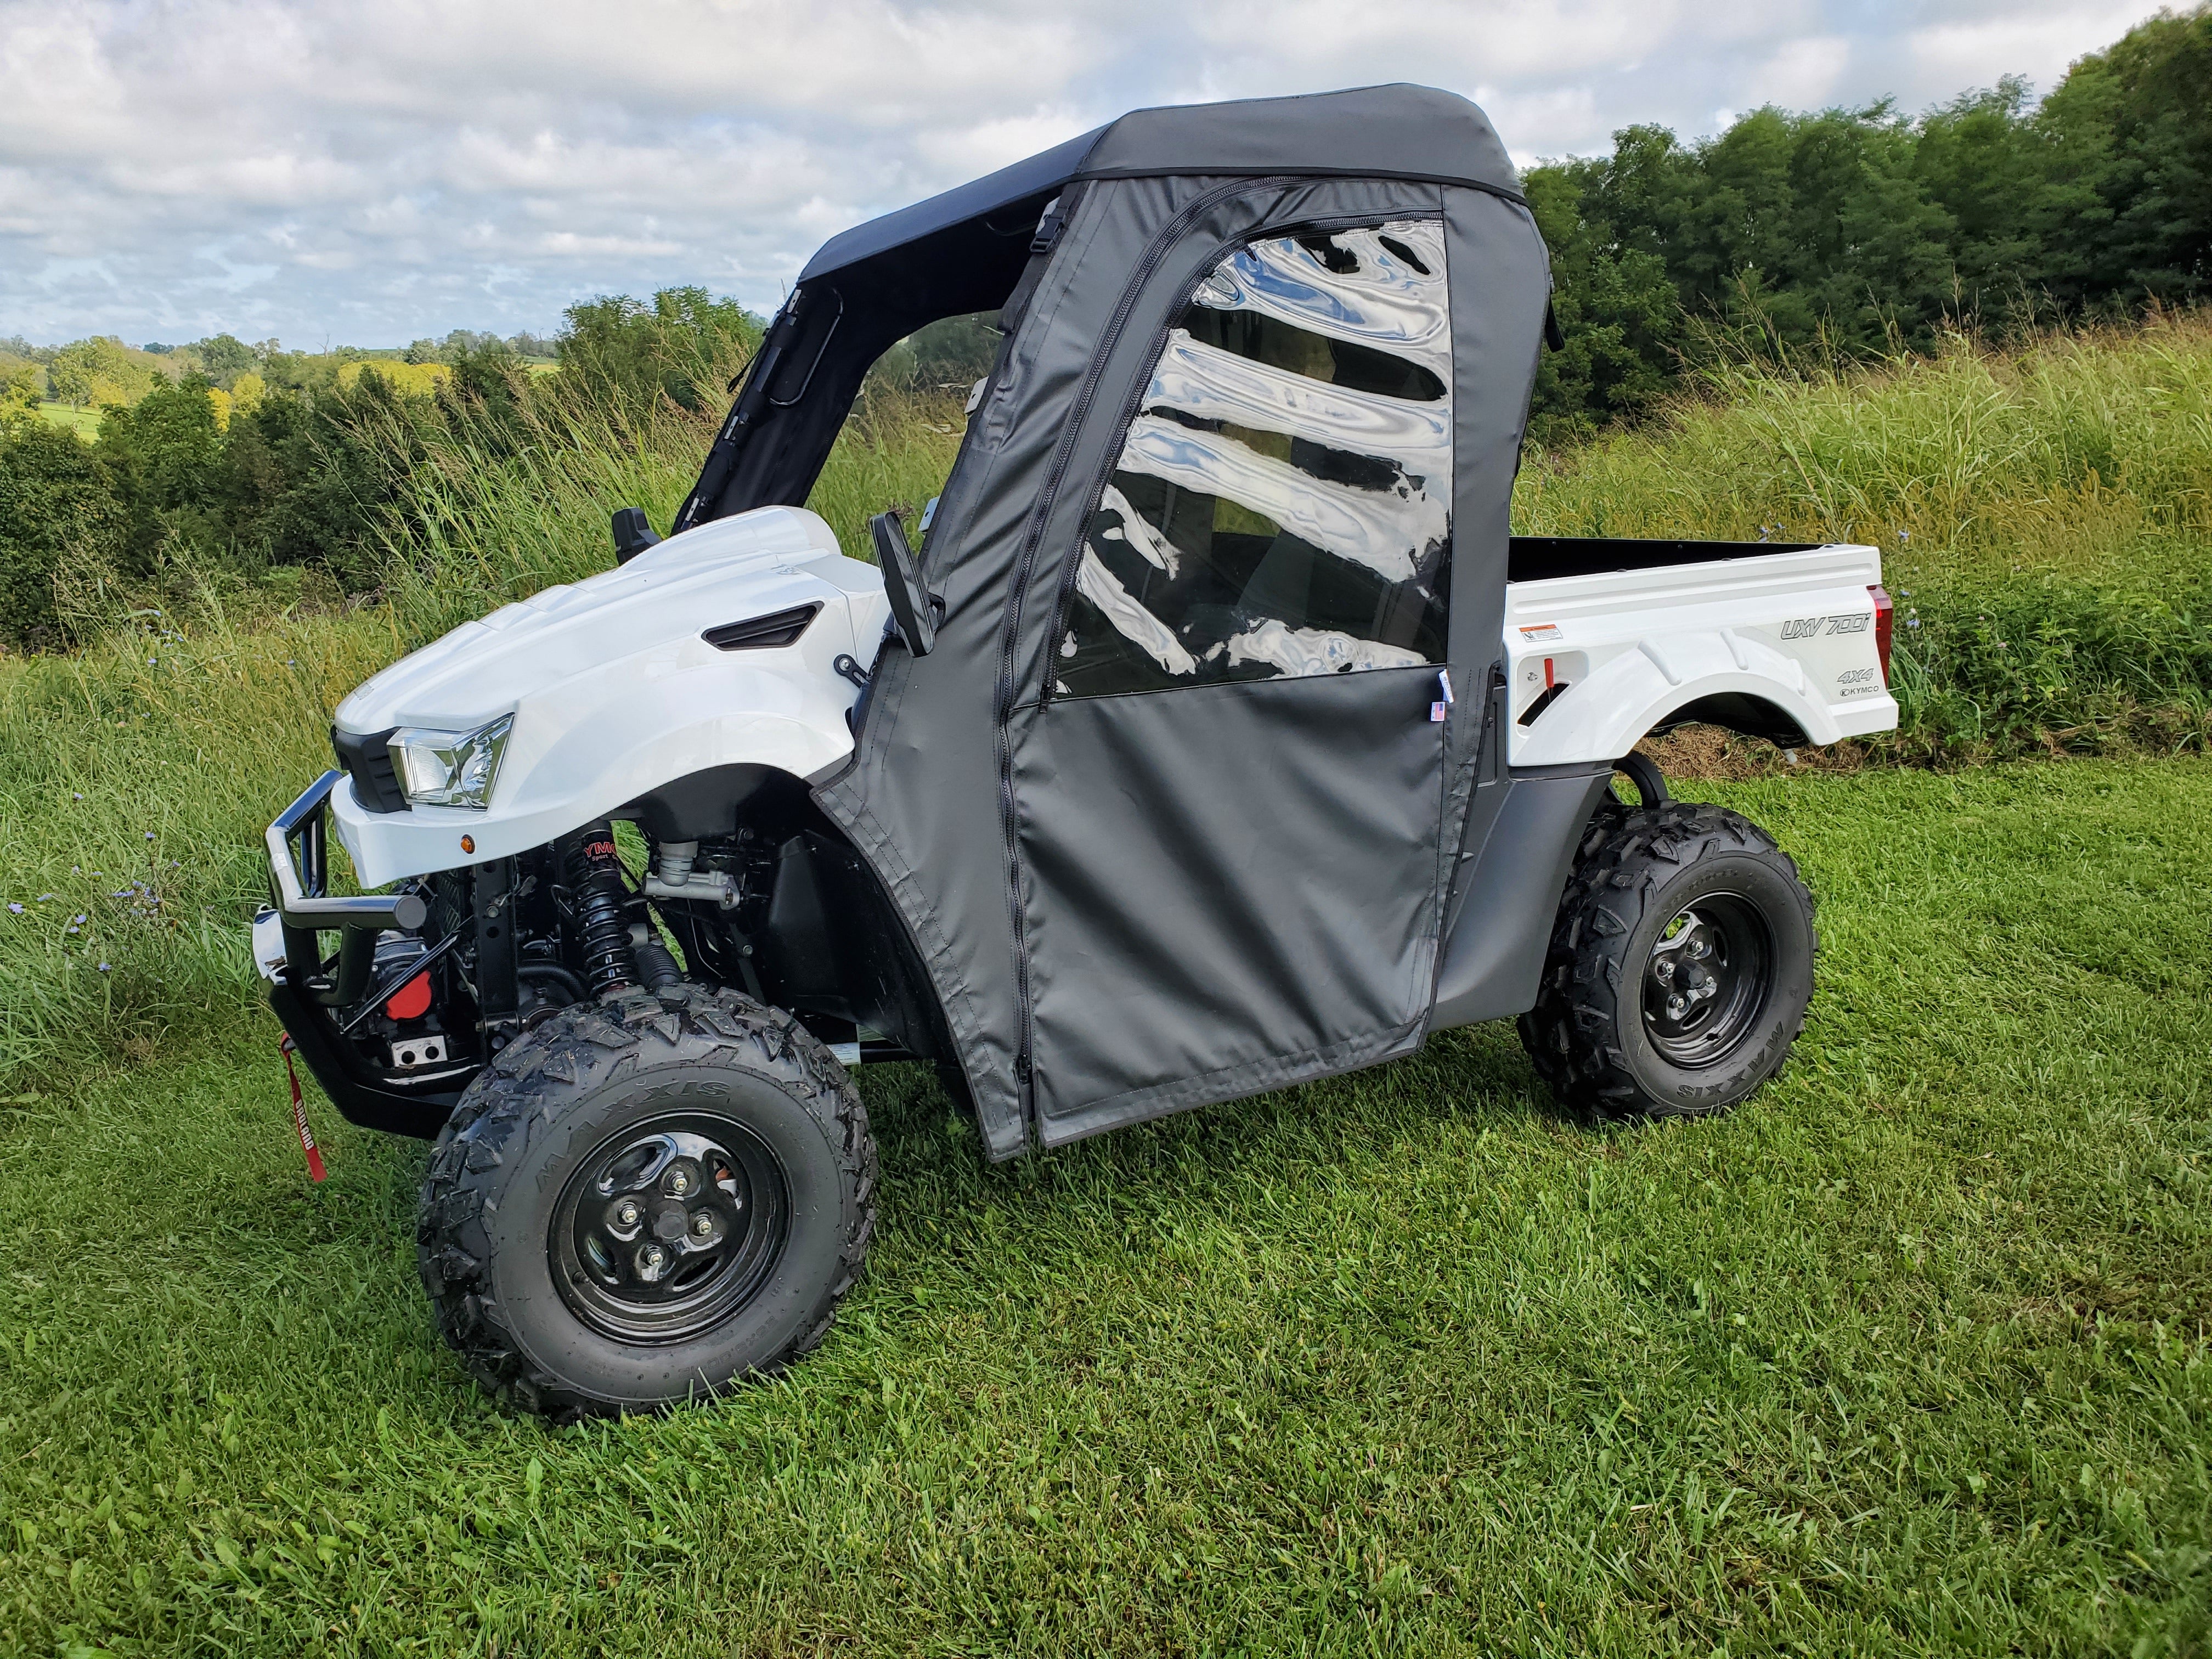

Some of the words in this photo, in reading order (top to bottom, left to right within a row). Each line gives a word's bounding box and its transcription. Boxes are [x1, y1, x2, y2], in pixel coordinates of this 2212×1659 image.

[1781, 617, 1826, 640] UXV
[1825, 613, 1871, 636] 700i
[1850, 685, 1879, 695] KYMCO
[1677, 1021, 1784, 1099] MAXXIS
[295, 1098, 314, 1150] BADLAND
[535, 1080, 731, 1193] MAXXIS
